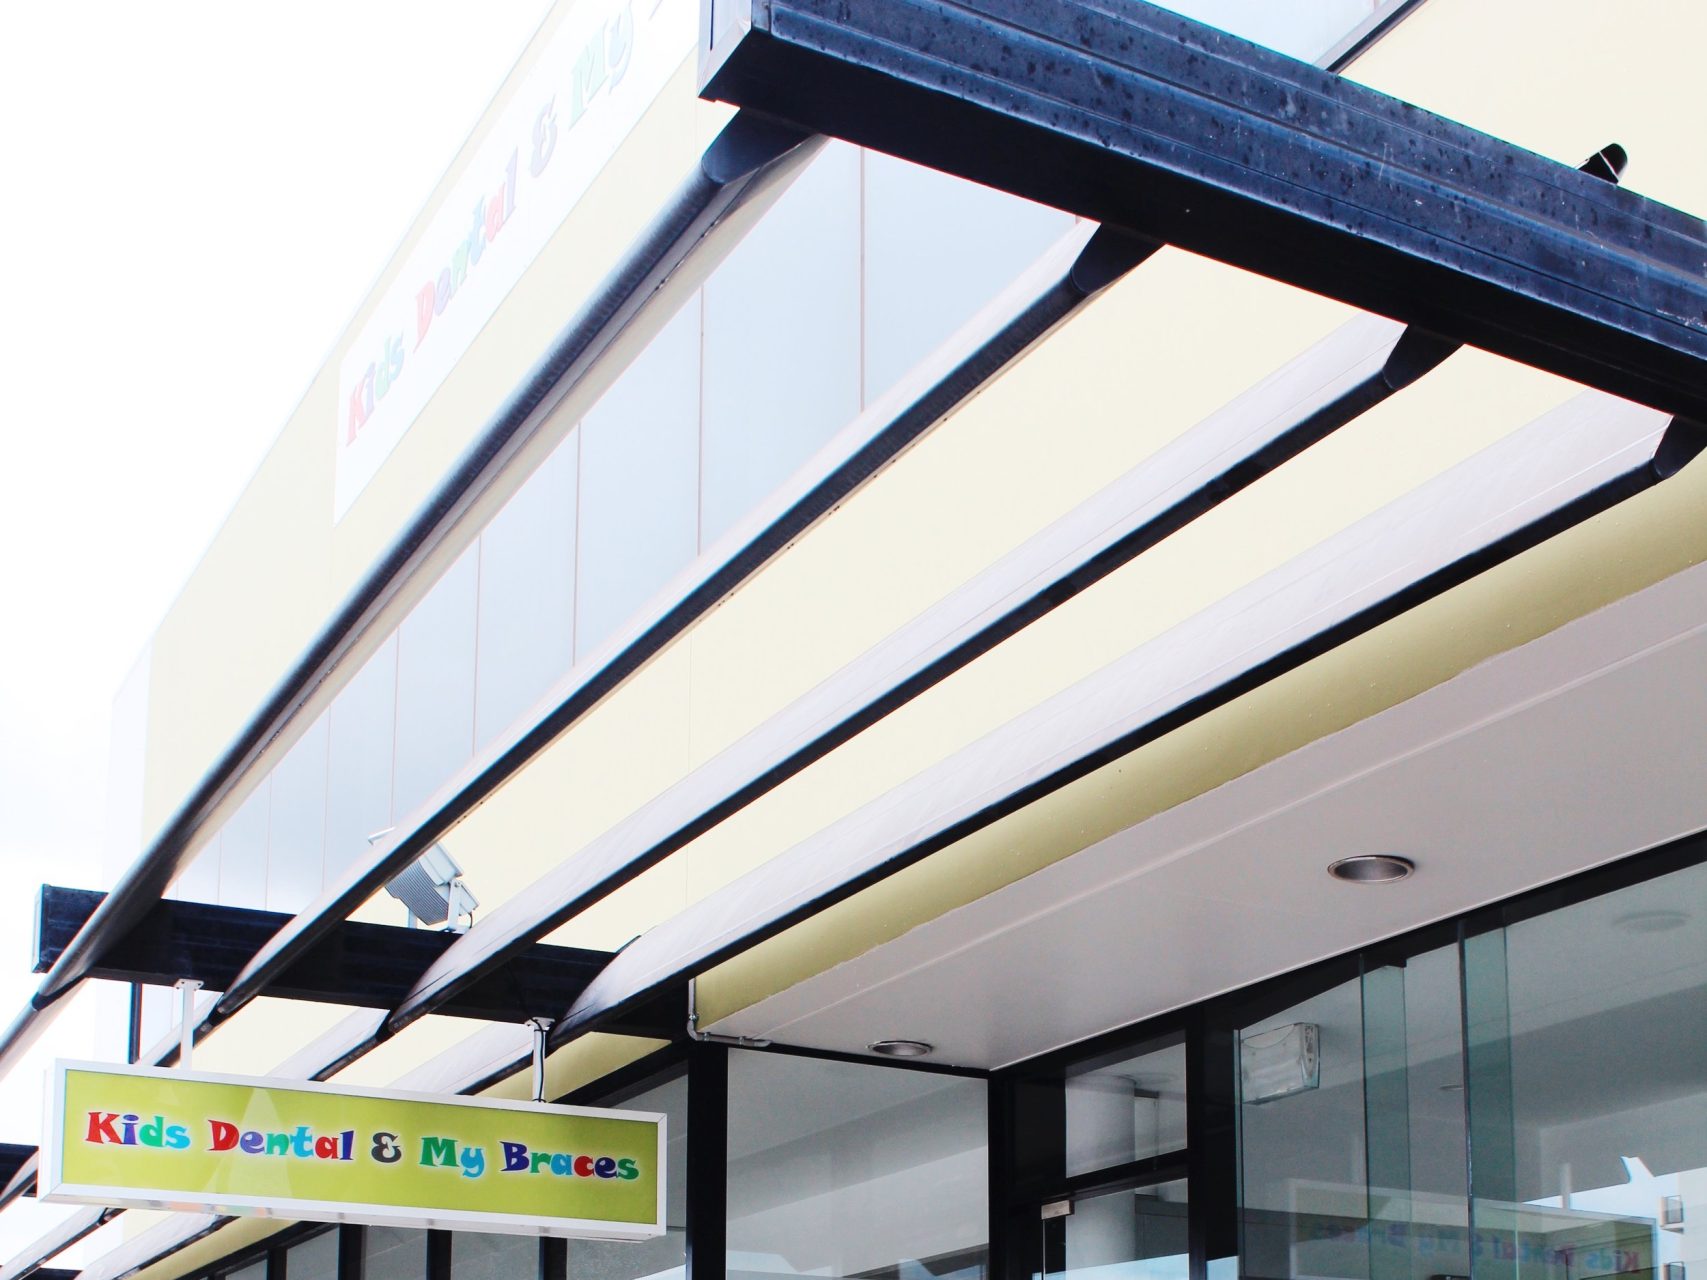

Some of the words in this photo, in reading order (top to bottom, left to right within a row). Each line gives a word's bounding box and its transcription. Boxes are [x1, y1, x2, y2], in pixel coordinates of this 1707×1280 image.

[346, 331, 405, 447] Kids
[413, 144, 518, 354] Dental
[529, 92, 558, 179] &
[569, 0, 634, 132] My
[85, 1111, 191, 1149] Kids
[207, 1119, 354, 1161] Dental
[371, 1132, 402, 1163] &
[418, 1136, 485, 1178] My
[499, 1140, 640, 1180] Braces
